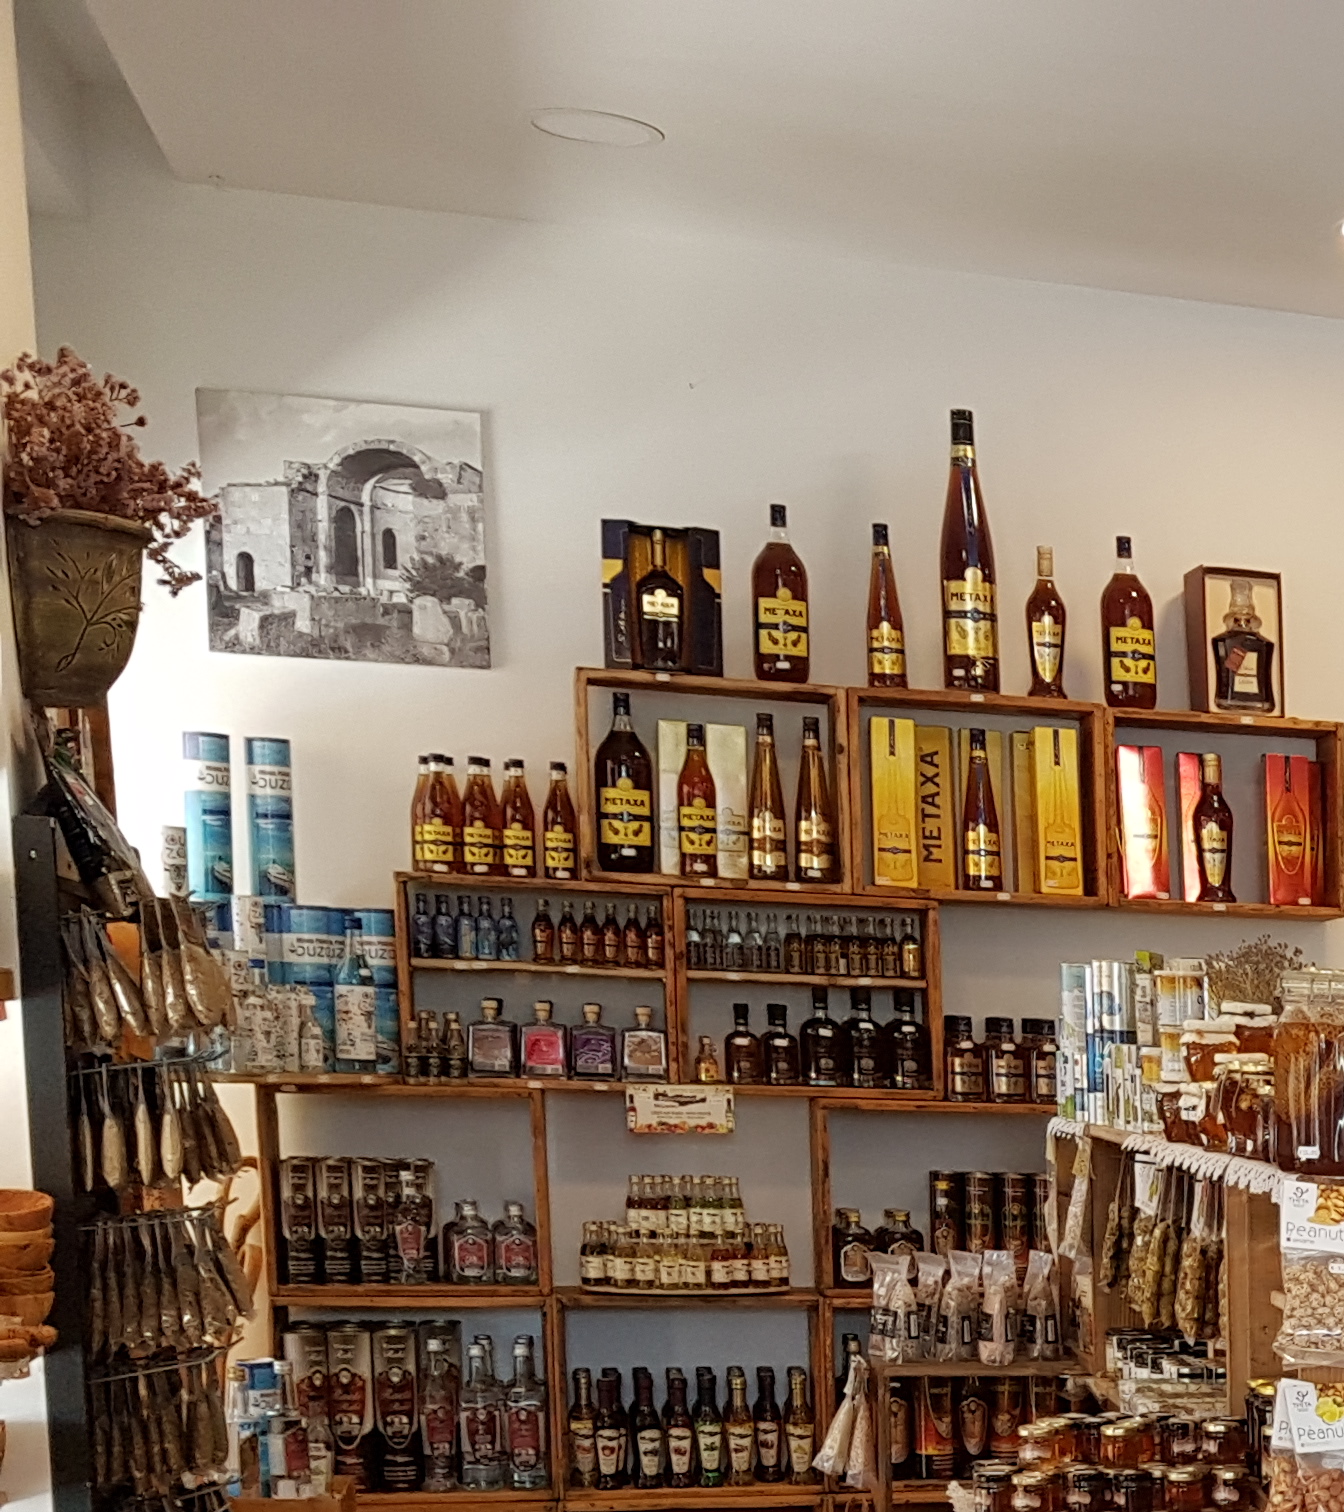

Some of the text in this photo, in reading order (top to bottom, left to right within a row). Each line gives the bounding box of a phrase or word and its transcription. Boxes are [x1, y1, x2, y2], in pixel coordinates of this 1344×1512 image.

[1115, 636, 1152, 646] METAXA
[604, 797, 646, 807] METAXA
[919, 750, 943, 863] METAXA
